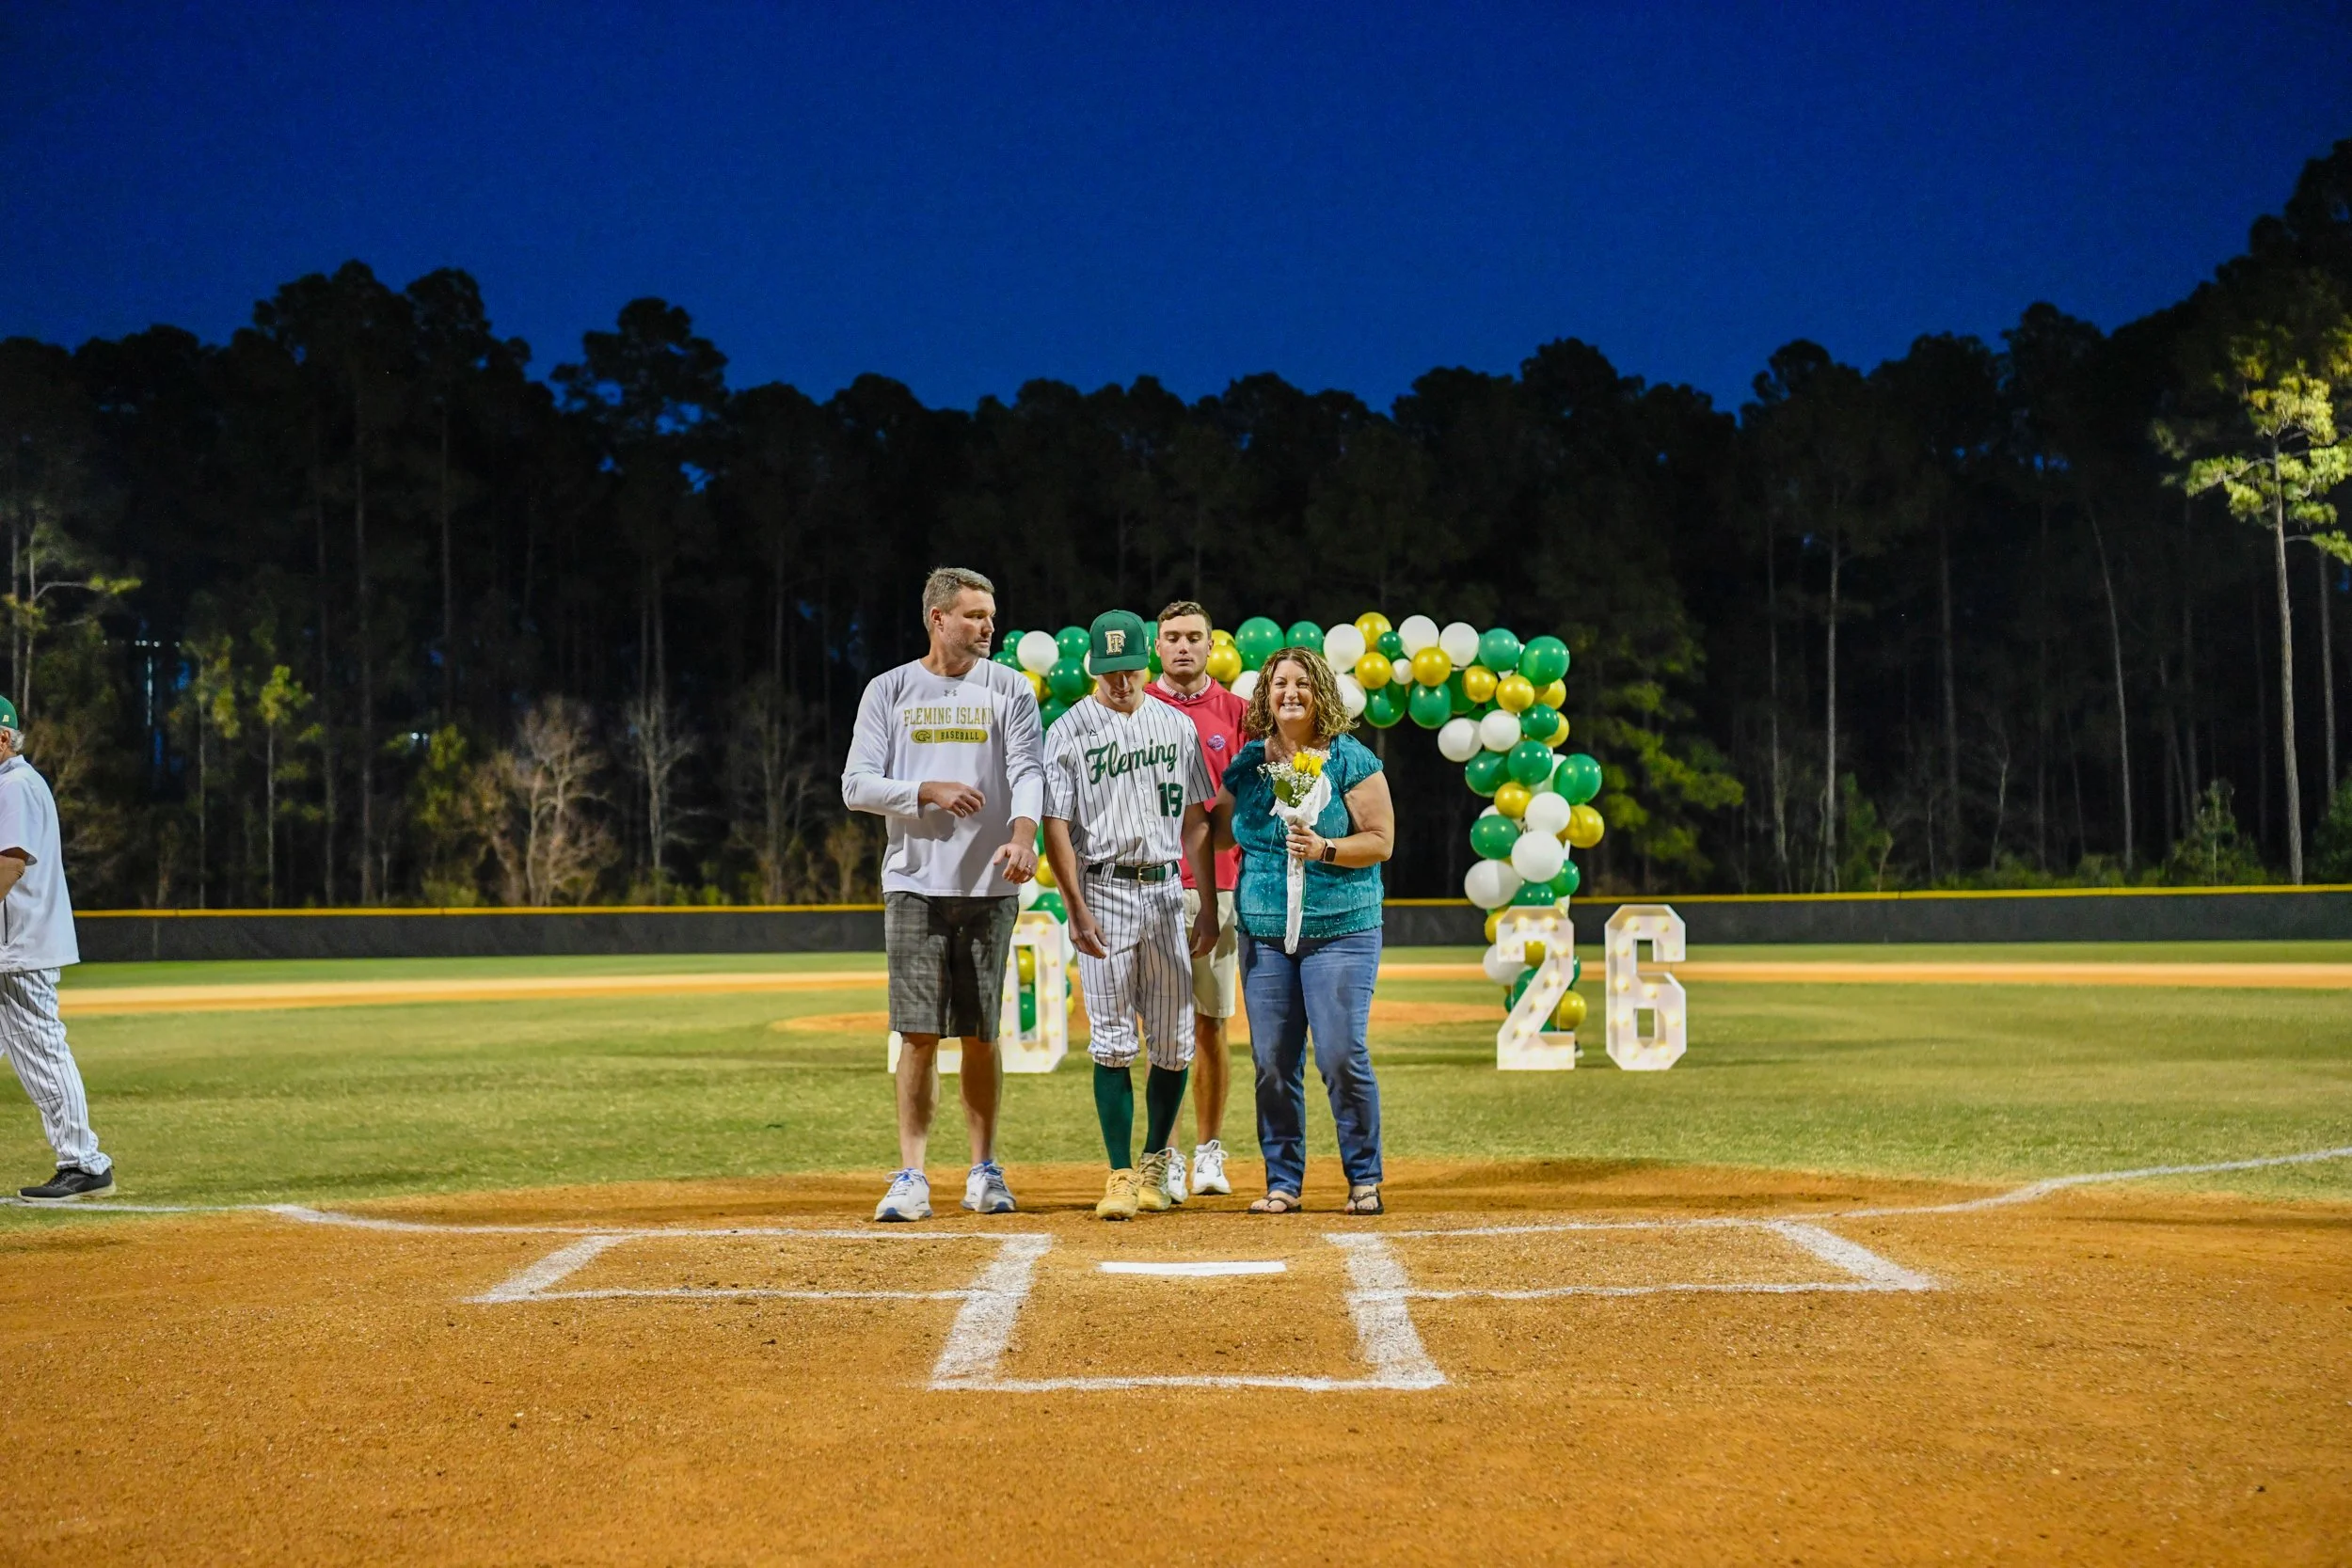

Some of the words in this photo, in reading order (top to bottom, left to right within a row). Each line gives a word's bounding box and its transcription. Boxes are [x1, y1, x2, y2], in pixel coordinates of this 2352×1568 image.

[904, 707, 952, 727] FLEMING
[941, 730, 979, 740] BASEBALL
[1086, 738, 1177, 784] Fleming
